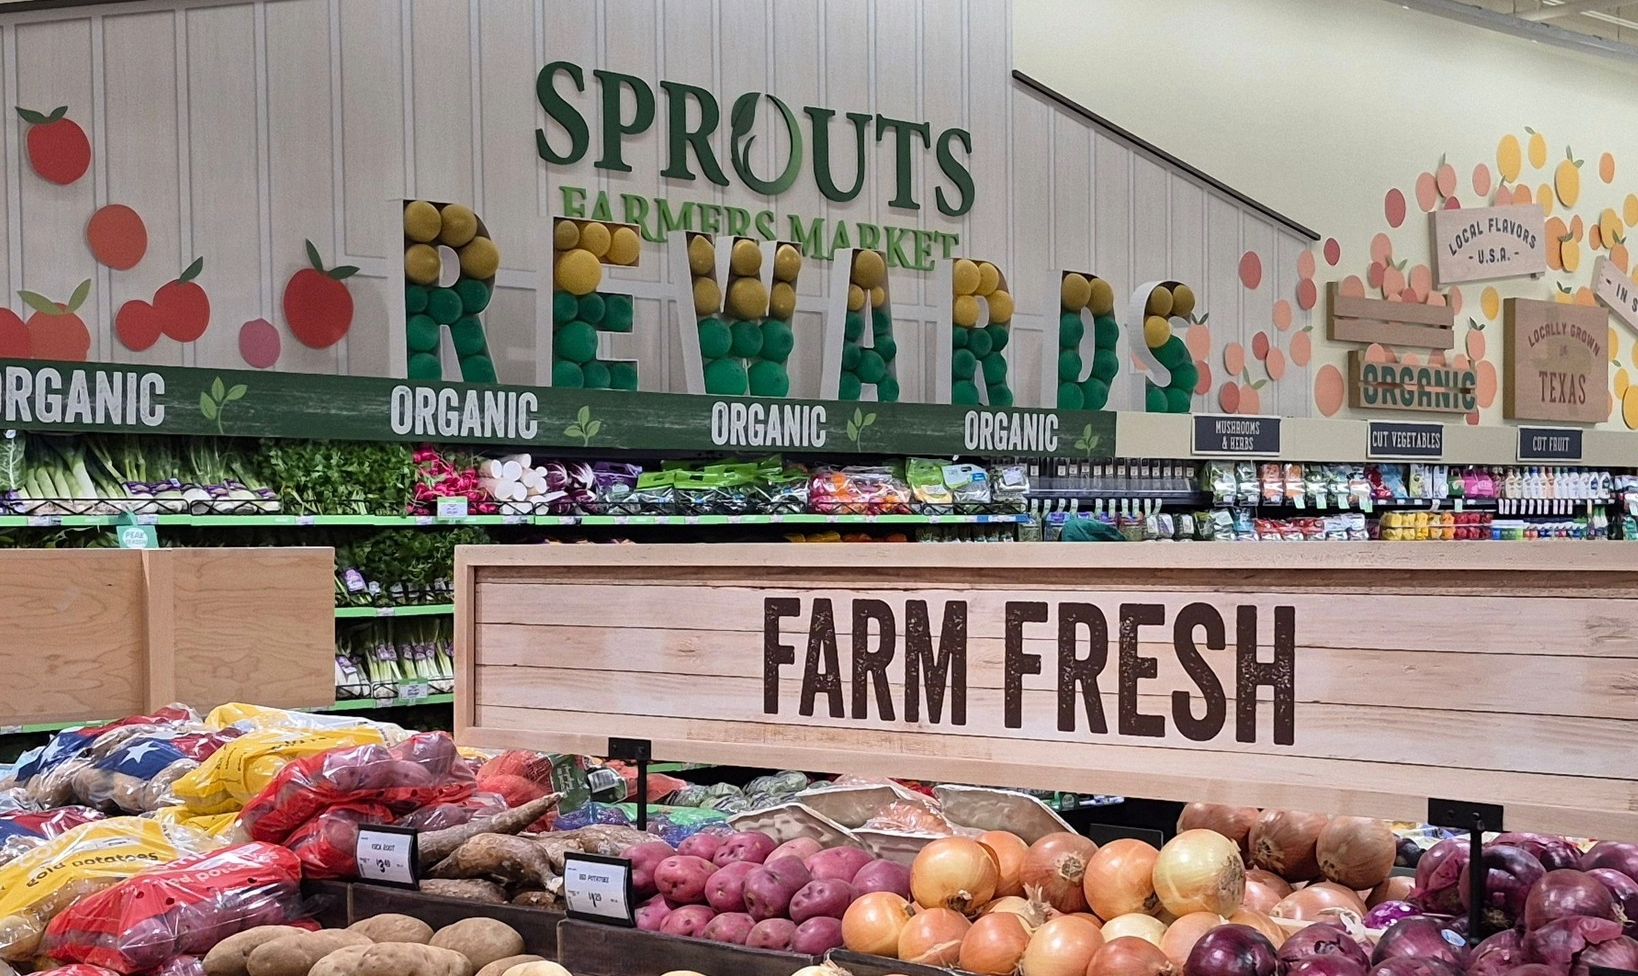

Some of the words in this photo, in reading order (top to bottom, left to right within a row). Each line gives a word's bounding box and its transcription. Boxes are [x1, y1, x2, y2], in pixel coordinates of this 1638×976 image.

[535, 60, 976, 218] SPROUTS
[559, 185, 777, 243] FARMERS
[786, 213, 960, 272] MARKET
[1448, 221, 1484, 256] LOCAL
[1488, 217, 1537, 249] FLAVORS
[396, 199, 1197, 416] REWARDS
[1616, 283, 1628, 304] IN
[1632, 297, 1638, 313] S
[1528, 321, 1568, 348] LOCALLY
[1570, 323, 1601, 357] GROWN
[0, 366, 166, 427] RGANIC
[1362, 363, 1476, 410] ORGANIC
[1538, 370, 1587, 405] TEXAS
[389, 385, 539, 440] ORGANIC
[710, 400, 827, 448] ORGANIC
[963, 410, 1059, 453] ORGANIC
[1215, 420, 1260, 435] MUSHROOMS
[1221, 435, 1228, 450] &
[1230, 436, 1254, 451] HERBS
[1371, 430, 1388, 448] CUT
[1391, 431, 1441, 449] VEGETABLES
[1532, 435, 1547, 452] CUT
[1548, 436, 1570, 452] FRUIT
[763, 597, 968, 726] FARM
[1003, 601, 1296, 746] FRESH
